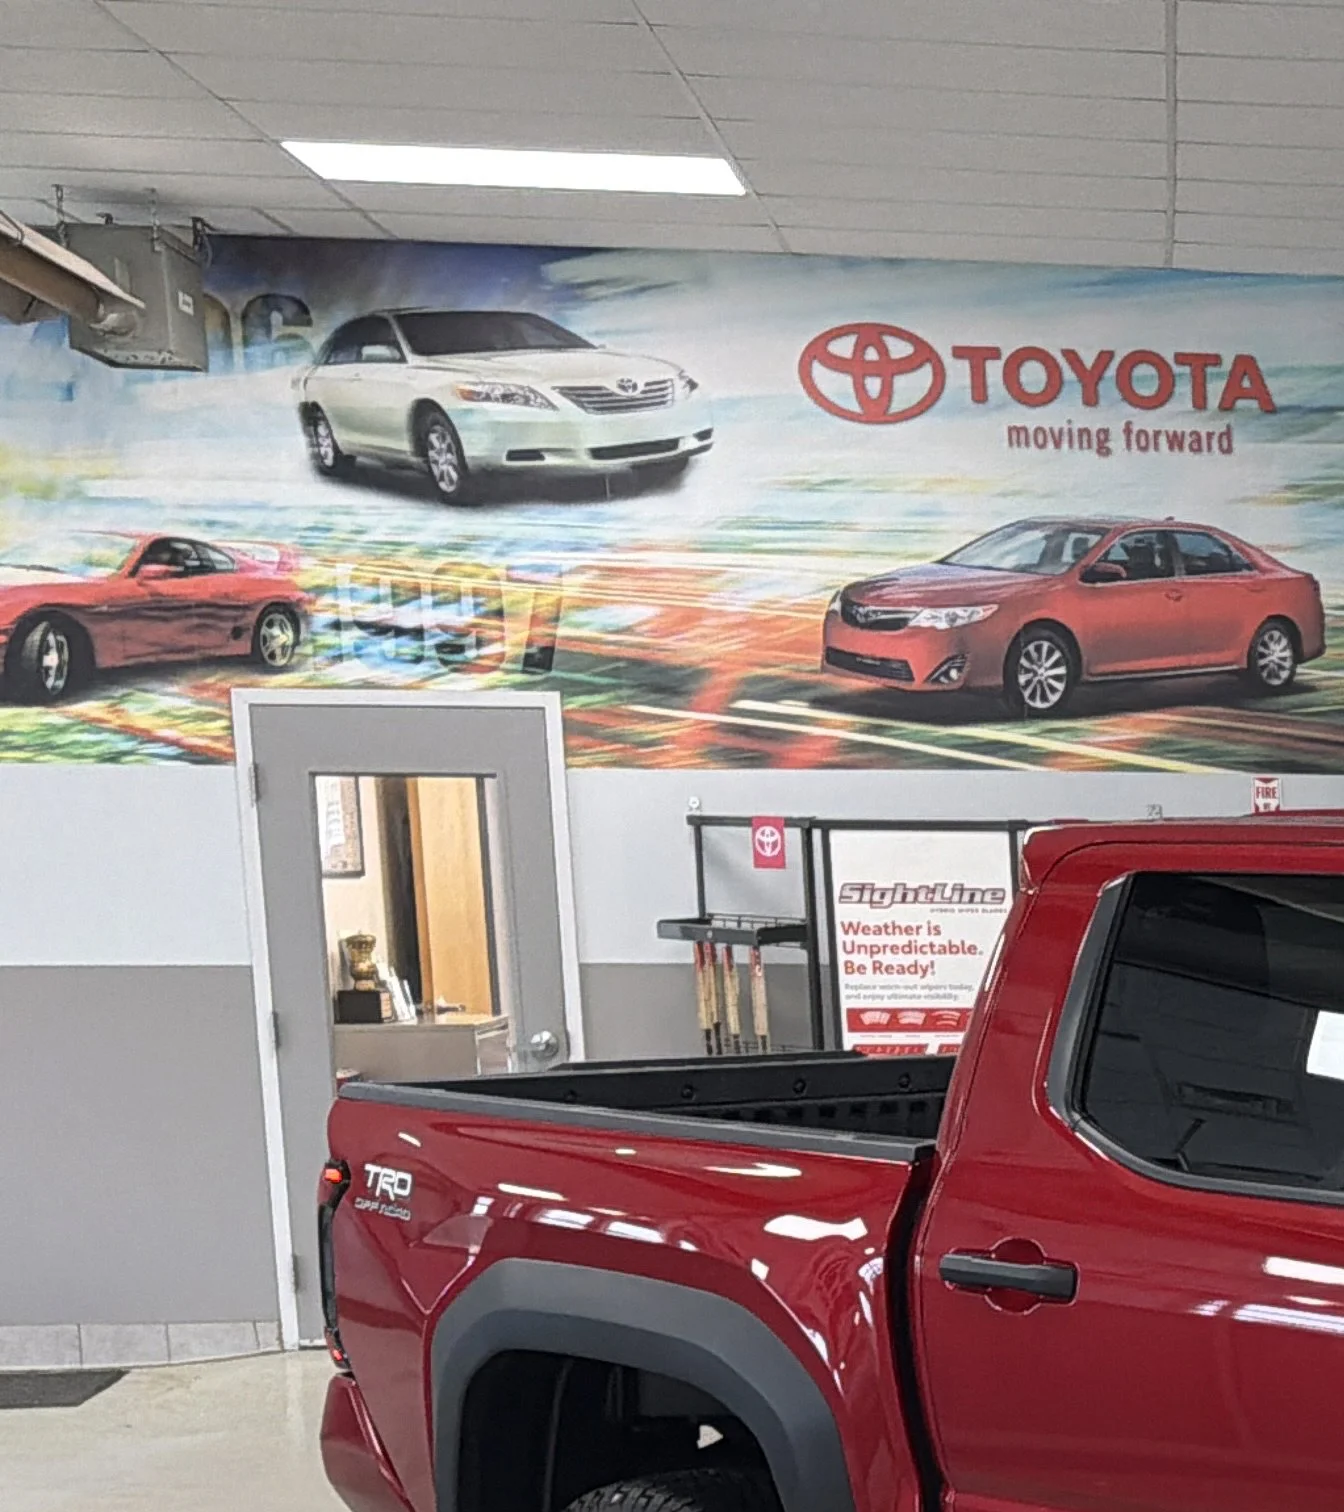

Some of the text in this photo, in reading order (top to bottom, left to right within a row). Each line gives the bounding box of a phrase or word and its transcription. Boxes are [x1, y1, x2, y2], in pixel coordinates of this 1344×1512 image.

[952, 345, 1277, 414] TOYOTA
[1007, 420, 1234, 457] moving forward
[1255, 786, 1277, 799] FIRE
[838, 882, 1006, 909] SightLine
[841, 920, 941, 936] Weather is
[842, 940, 984, 959] Unpredictable.
[844, 960, 936, 978] Be Ready!
[364, 1163, 413, 1201] TRD
